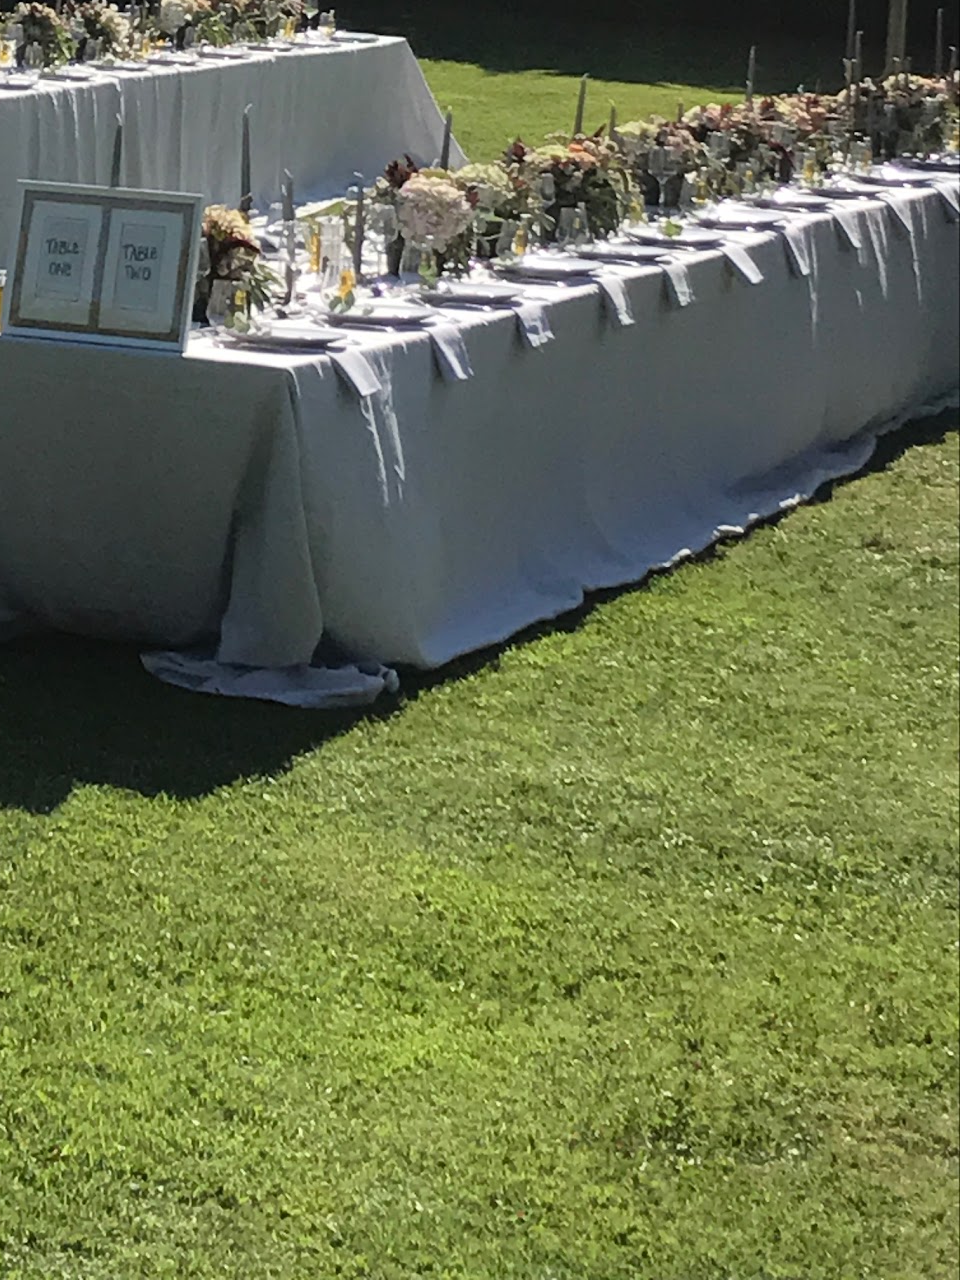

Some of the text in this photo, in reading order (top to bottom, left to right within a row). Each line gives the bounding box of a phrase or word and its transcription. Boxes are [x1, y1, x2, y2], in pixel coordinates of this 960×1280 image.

[46, 238, 79, 255] TABLE
[122, 244, 157, 261] TABLE
[48, 262, 72, 277] ONE
[125, 265, 152, 281] TWO
